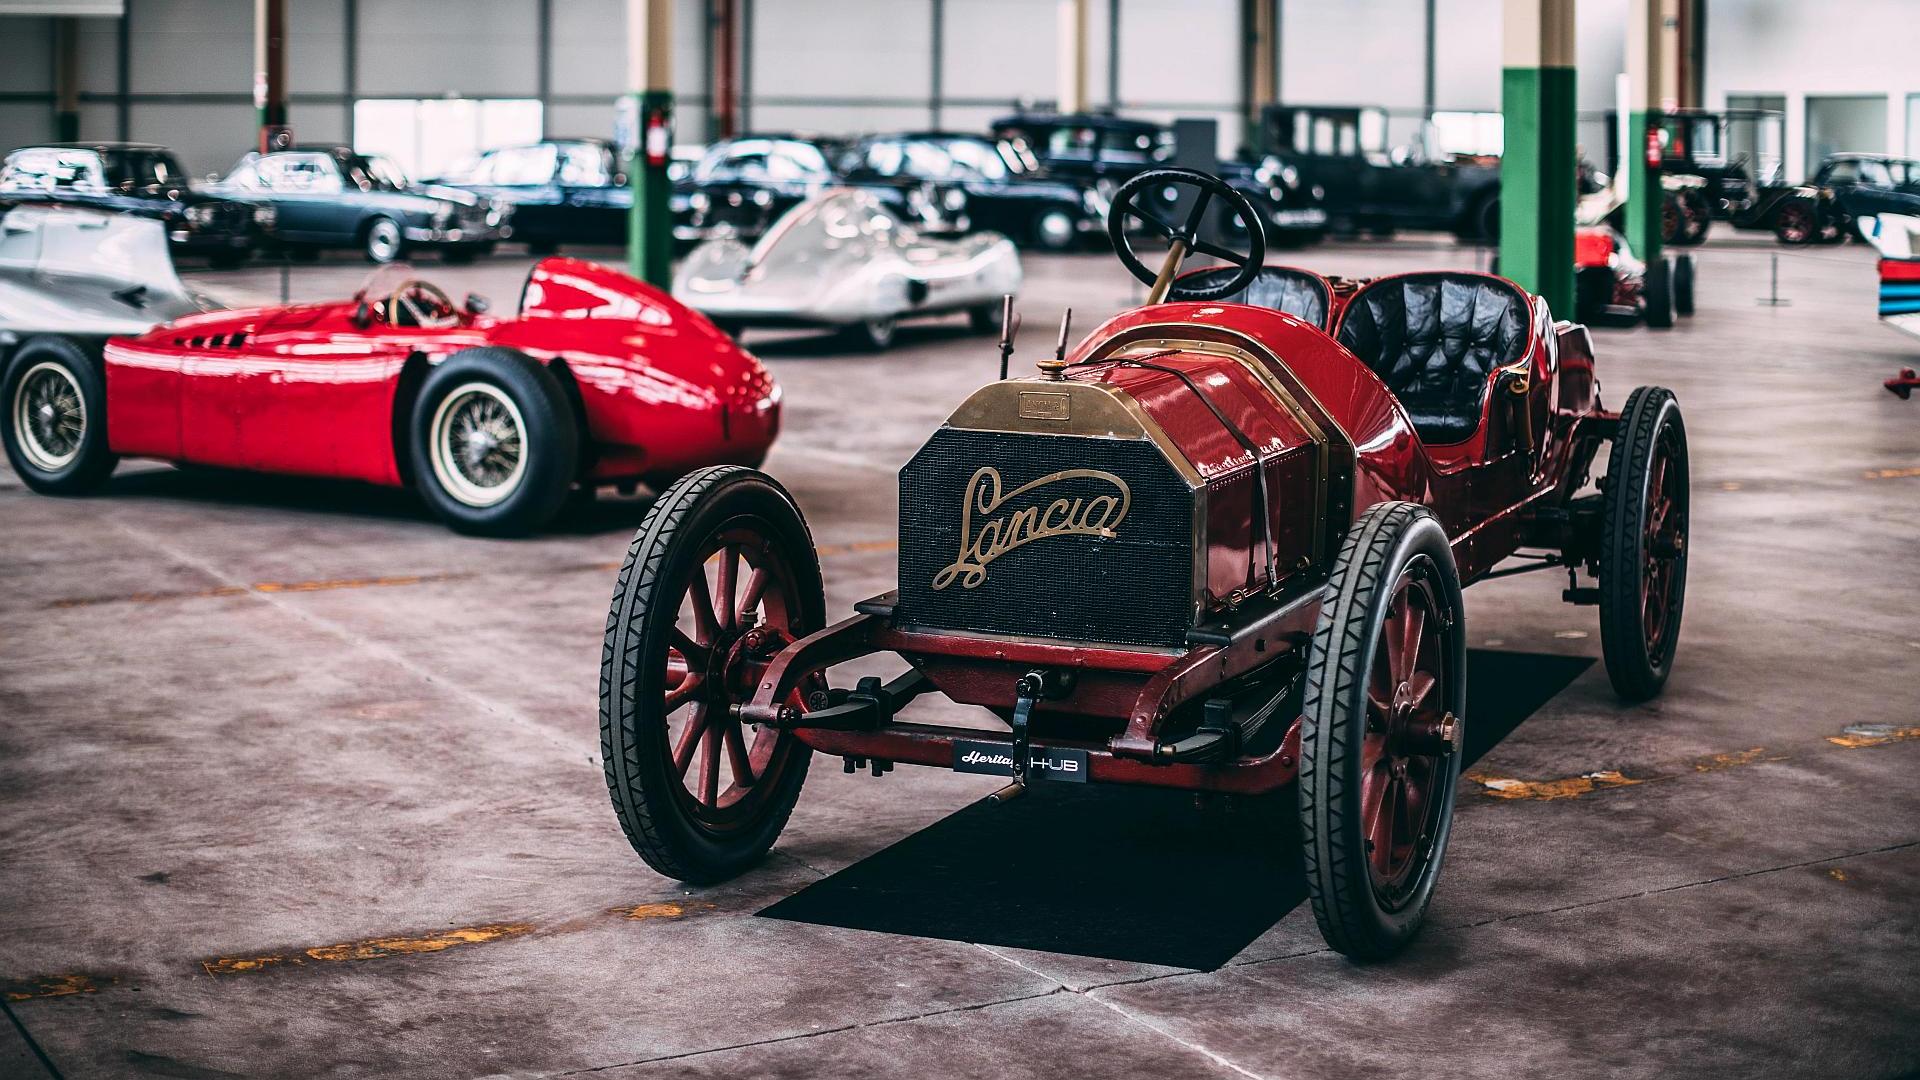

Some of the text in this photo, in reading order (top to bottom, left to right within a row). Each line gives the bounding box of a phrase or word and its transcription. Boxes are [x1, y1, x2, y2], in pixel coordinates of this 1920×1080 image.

[932, 466, 1131, 590] Lancia
[961, 750, 1079, 771] Herita HUB
